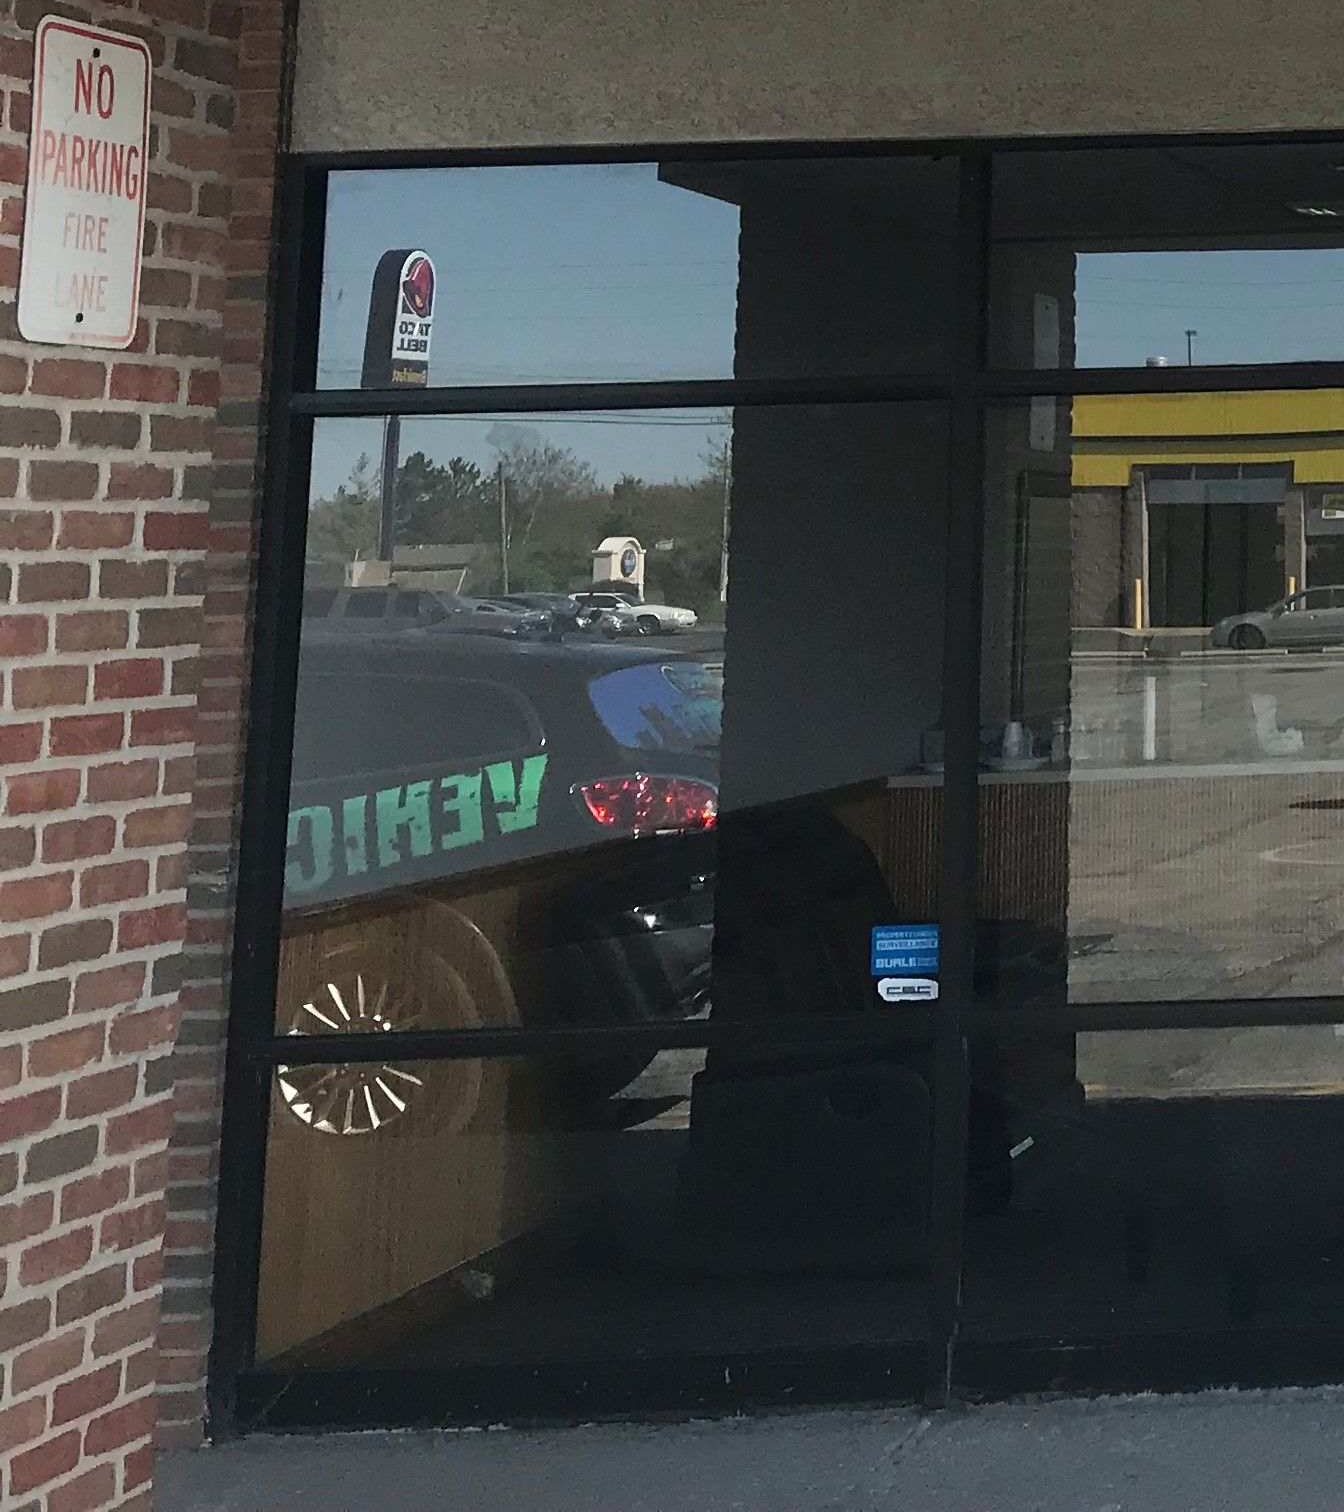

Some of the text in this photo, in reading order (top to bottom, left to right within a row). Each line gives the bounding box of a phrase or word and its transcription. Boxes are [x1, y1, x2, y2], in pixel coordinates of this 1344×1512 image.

[73, 58, 115, 120] NO
[40, 129, 140, 200] PARKING
[63, 212, 110, 254] FIRE
[54, 271, 109, 313] LANE
